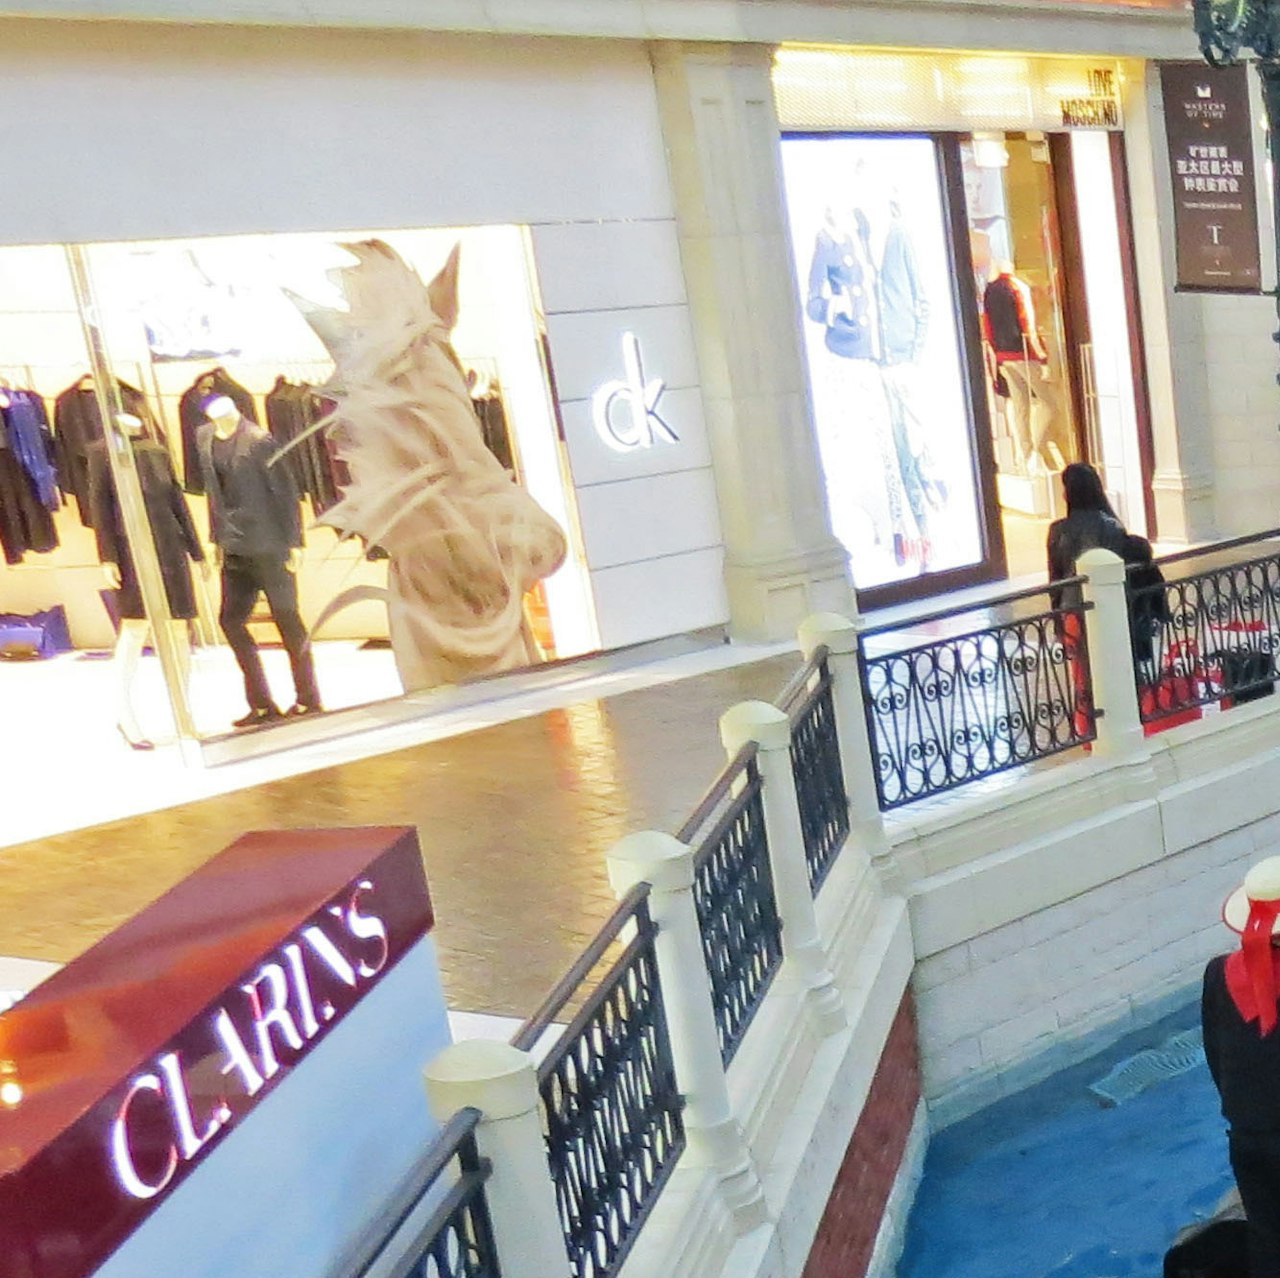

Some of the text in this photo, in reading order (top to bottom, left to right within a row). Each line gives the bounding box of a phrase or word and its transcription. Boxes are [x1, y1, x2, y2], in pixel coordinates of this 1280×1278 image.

[1176, 160, 1244, 176] 亚太区最大型
[111, 880, 389, 1199] CLARINS
